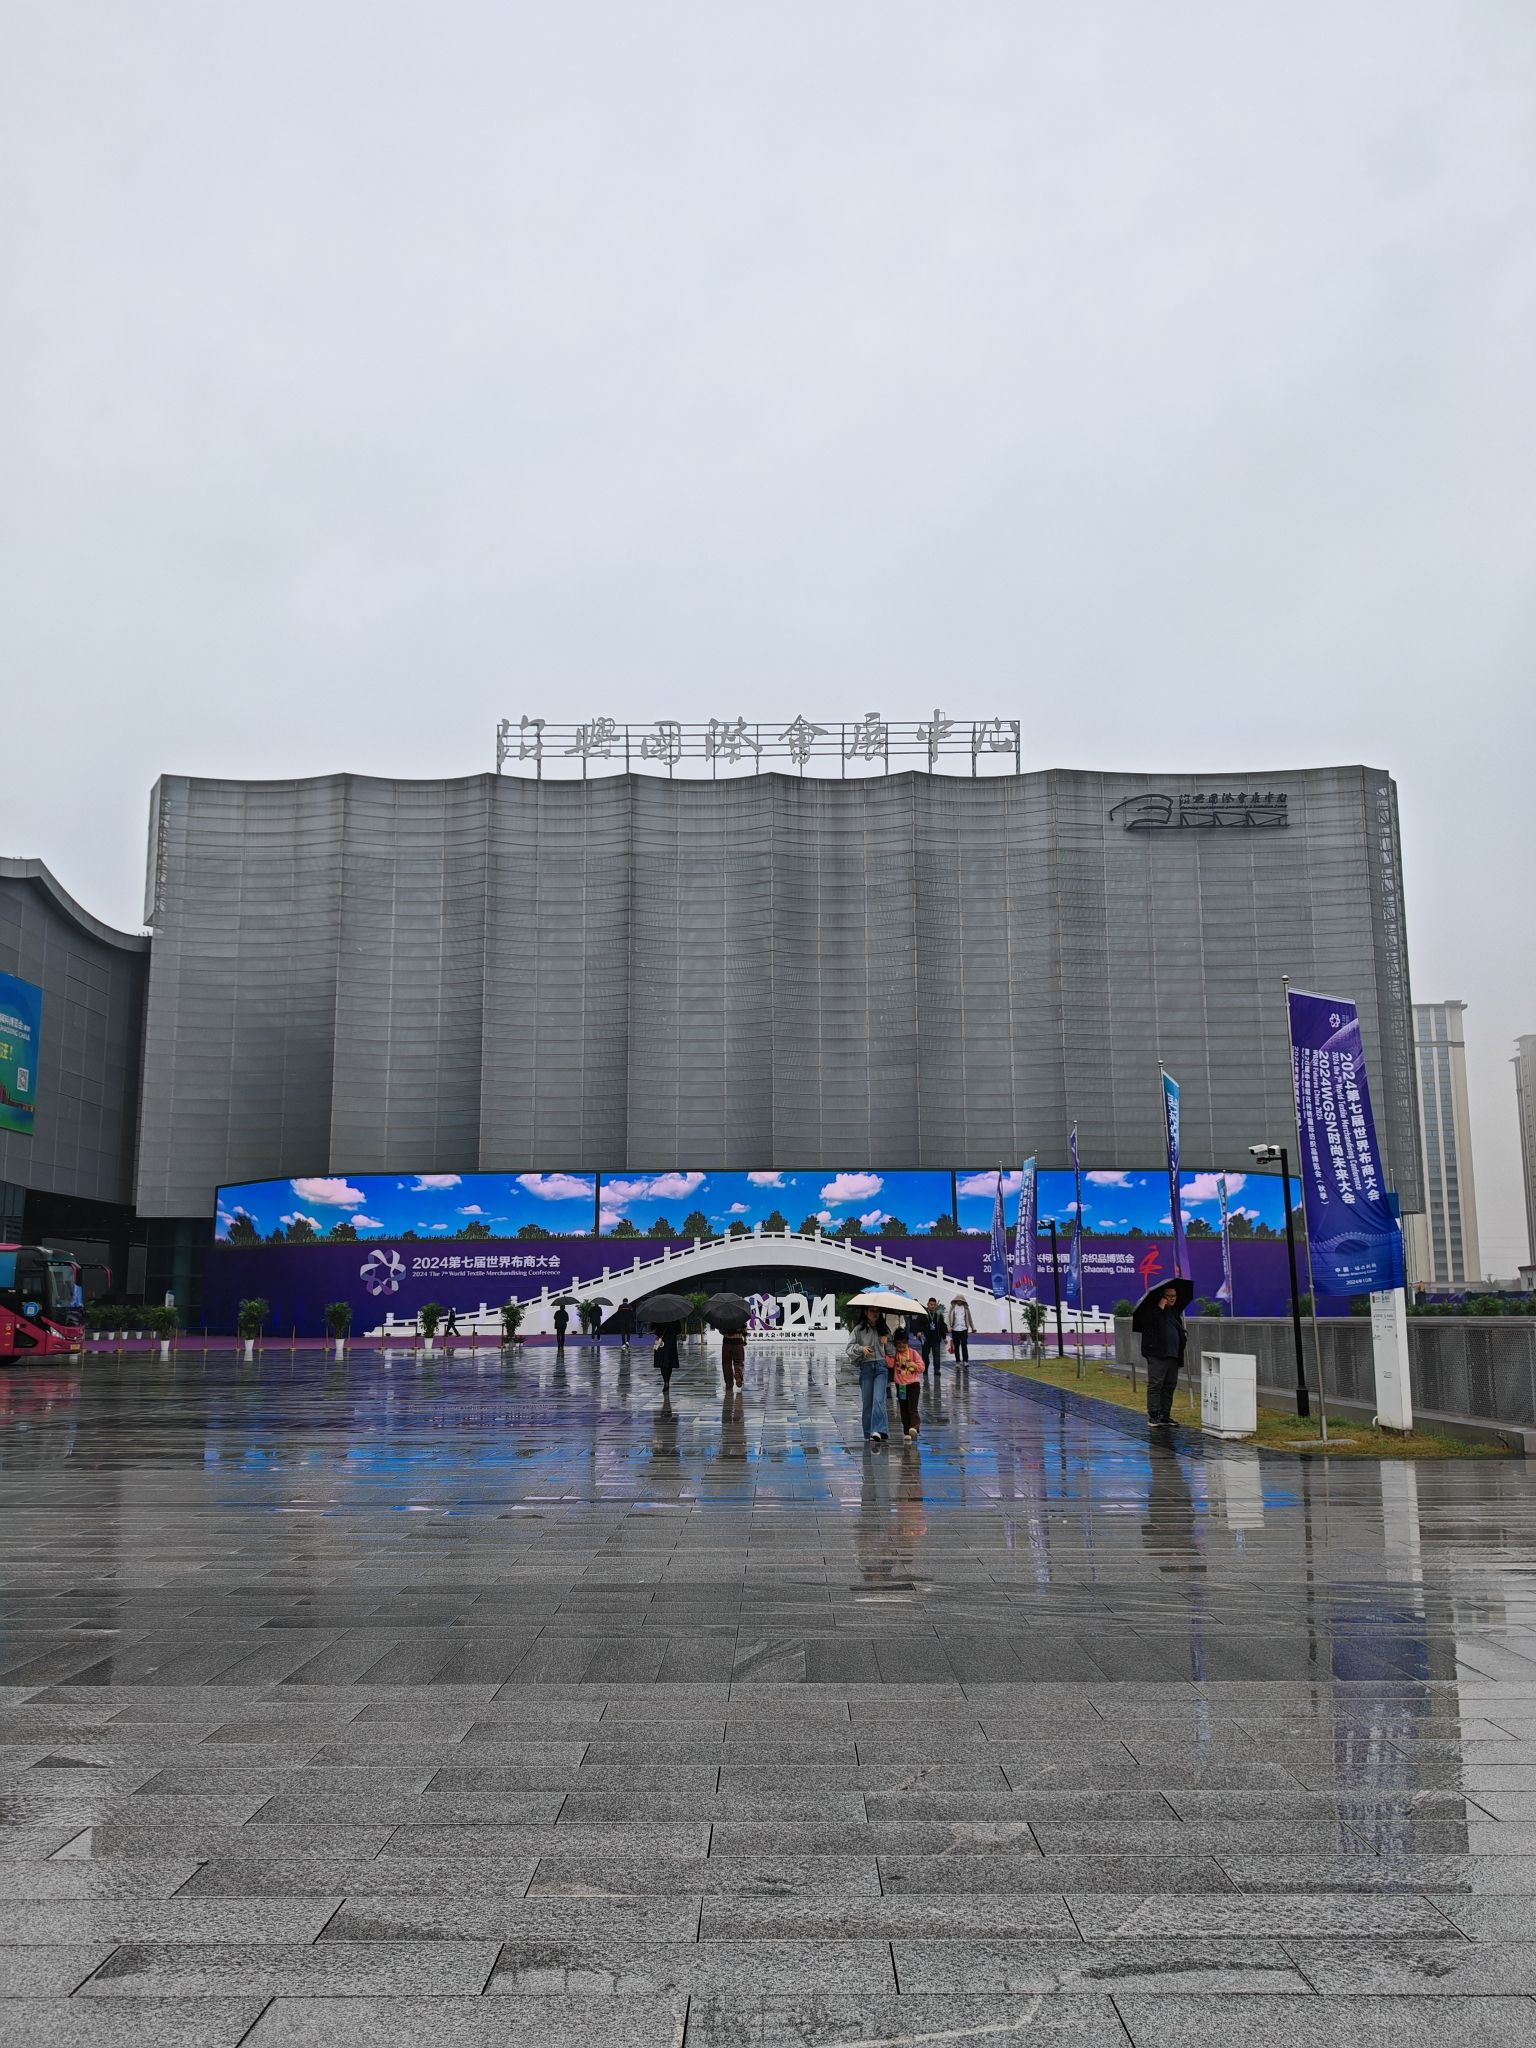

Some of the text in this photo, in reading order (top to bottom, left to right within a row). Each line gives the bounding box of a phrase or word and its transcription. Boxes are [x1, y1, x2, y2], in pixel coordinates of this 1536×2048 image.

[412, 1255, 561, 1270] 2024第七届世界布商大会
[1116, 1265, 1135, 1274] China
